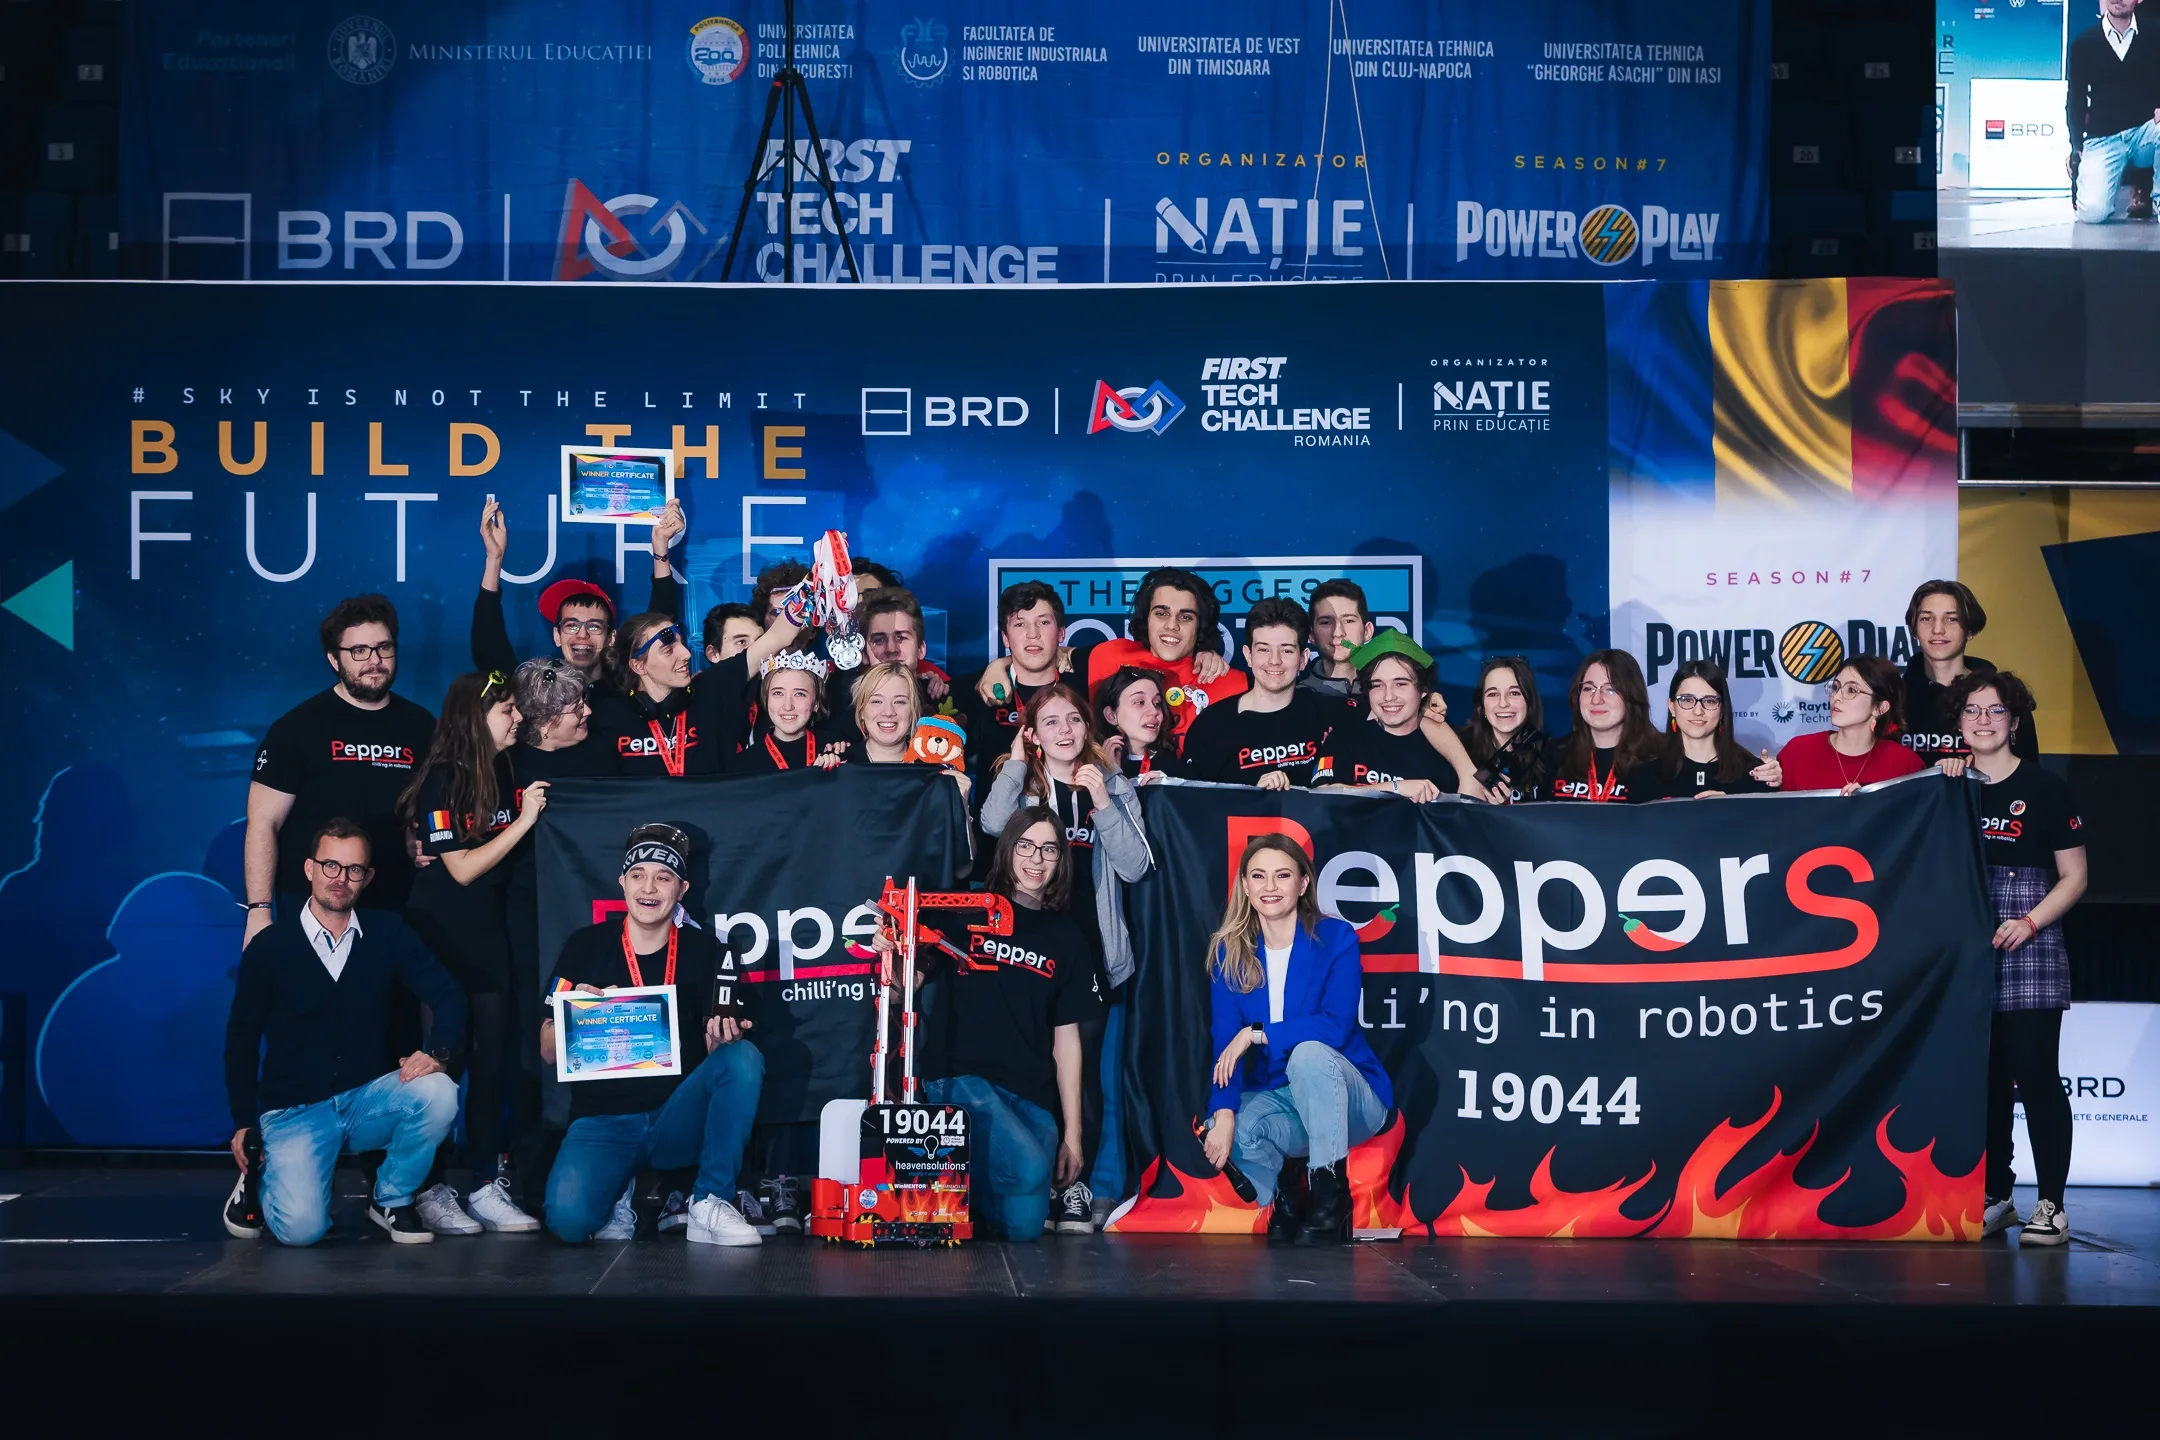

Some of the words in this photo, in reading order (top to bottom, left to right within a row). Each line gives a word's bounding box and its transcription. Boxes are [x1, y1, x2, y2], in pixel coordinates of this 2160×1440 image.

[758, 24, 854, 39] UNIVRSITATEA
[963, 26, 1035, 41] FACULTATEA
[1039, 27, 1055, 42] DE
[408, 43, 535, 60] MINISTERUL
[758, 43, 840, 59] POLIEHNICA
[963, 46, 1024, 61] INGINERIE
[1027, 47, 1108, 62] INDUSTRIALA
[1138, 36, 1241, 53] UNIVERSITATEA
[1246, 38, 1263, 54] DE
[1268, 38, 1301, 54] VEST
[1333, 39, 1433, 57] UNIVERSITATEA
[1437, 40, 1494, 58] TEHNICA
[1543, 42, 1642, 61] UNIVERSITATEA
[1646, 45, 1704, 62] TEHNICA
[962, 66, 974, 80] SI
[978, 66, 1038, 81] ROBOTICA
[1168, 58, 1191, 75] DIN
[1196, 58, 1271, 75] TIMISOARA
[1354, 60, 1378, 78] DIN
[1381, 60, 1472, 79] CLUJ-NAPOCA
[1667, 66, 1692, 84] DIN
[1695, 67, 1722, 84] IASI
[2011, 124, 2054, 137] BRD
[757, 138, 911, 183] FIRST
[1156, 152, 1367, 168] ORGANIZATOR
[757, 192, 894, 235] TECH
[278, 210, 465, 270] BRD
[1456, 201, 1578, 262] POWER
[756, 243, 1059, 283] CHALLENGE
[1201, 356, 1287, 380] FIRST
[1430, 358, 1548, 366] ORGANIZATOR
[183, 388, 270, 404] SKY
[308, 389, 357, 405] IS
[395, 389, 482, 406] NOT
[519, 390, 607, 408] THE
[644, 391, 806, 409] LIMIT
[1201, 384, 1278, 406] TECH
[925, 396, 1029, 427] BRD
[1201, 408, 1371, 432] CHALLENGE
[1433, 419, 1469, 431] PRIN
[131, 420, 500, 477] BUILD
[585, 424, 806, 480] THE
[1294, 435, 1371, 447] ROMANIA
[610, 471, 655, 480] CERTIFICATE
[576, 1017, 608, 1025] WINNER
[609, 1014, 657, 1024] CERTIFICATE
[1539, 996, 1596, 1039] in
[1639, 987, 1884, 1039] robotics
[2060, 1077, 2126, 1098] BRD
[1457, 1069, 1641, 1125] 19044
[879, 1109, 965, 1135] 19044
[2094, 1113, 2149, 1122] GENERALE
[895, 1161, 966, 1171] heavensolutions
